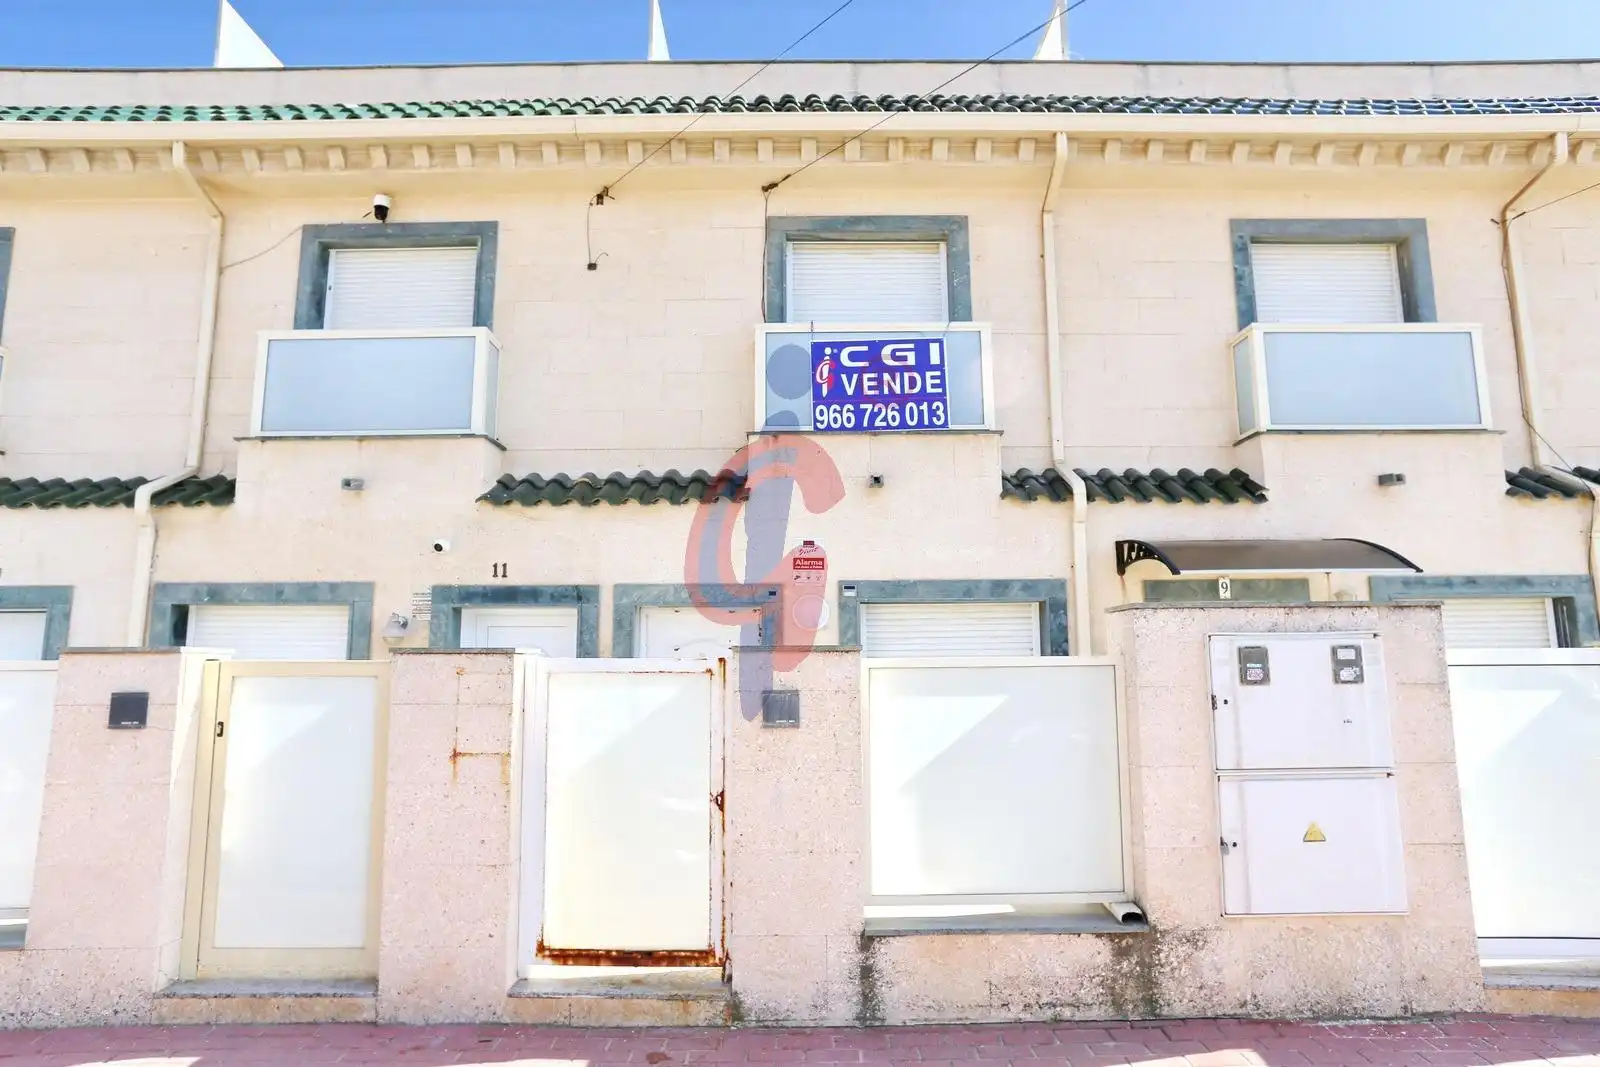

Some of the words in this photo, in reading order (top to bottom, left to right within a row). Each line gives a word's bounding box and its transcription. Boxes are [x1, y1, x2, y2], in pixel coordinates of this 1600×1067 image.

[840, 342, 941, 367] CGI
[841, 371, 943, 396] VENDE
[815, 404, 856, 429] 966
[860, 402, 900, 428] 726
[905, 401, 945, 426] 013
[492, 562, 508, 578] 11
[795, 558, 823, 566] Alarma
[1221, 581, 1229, 594] 9
